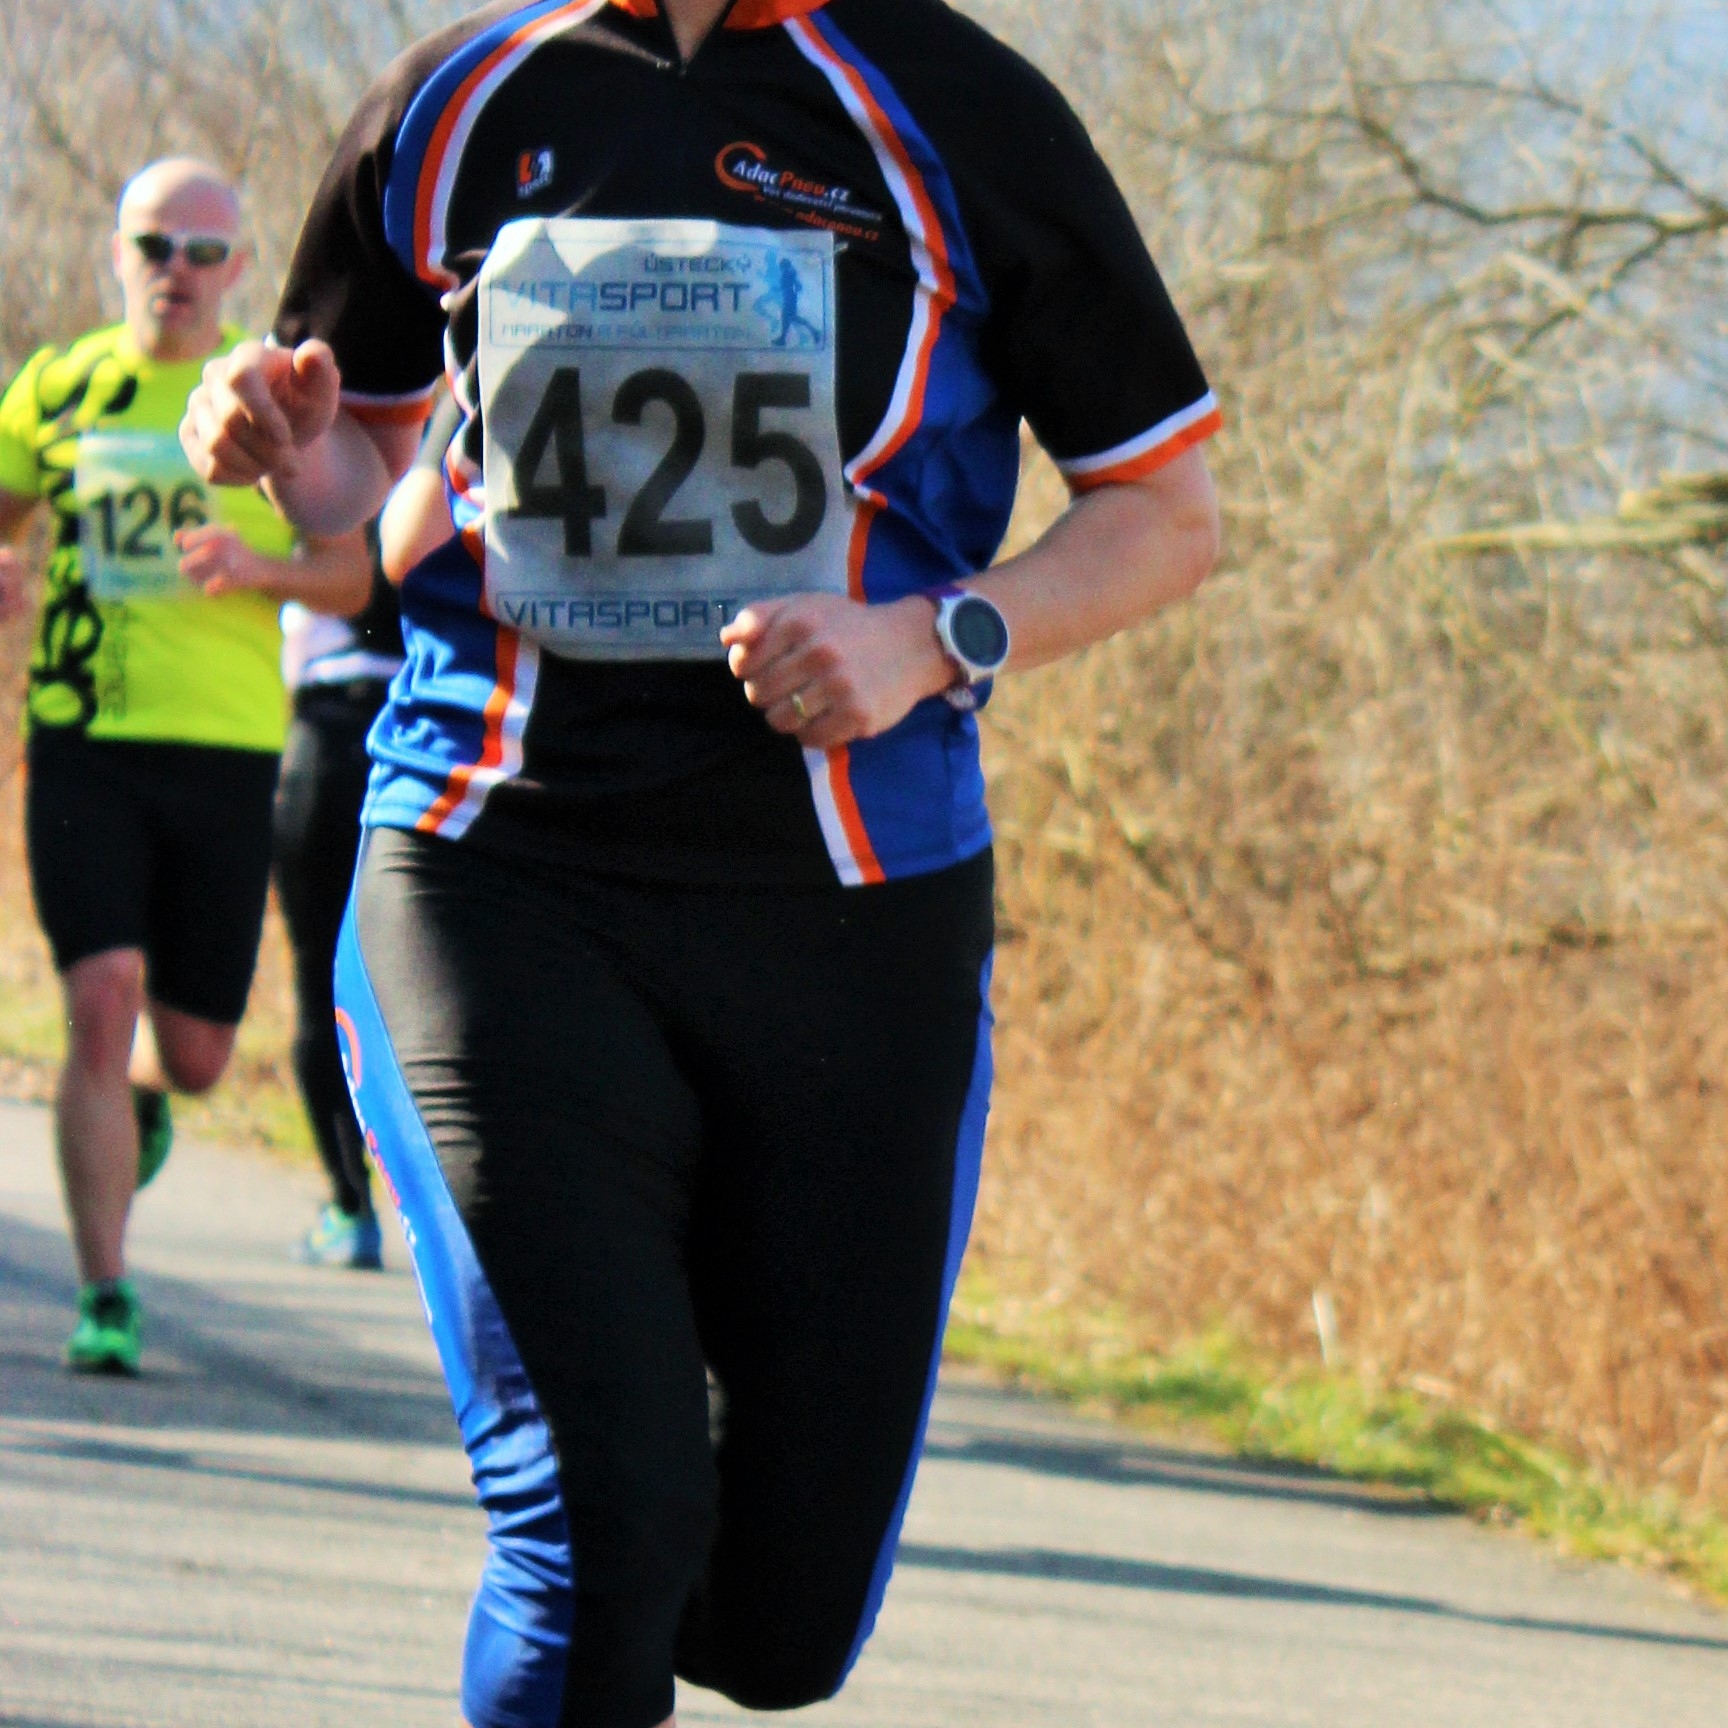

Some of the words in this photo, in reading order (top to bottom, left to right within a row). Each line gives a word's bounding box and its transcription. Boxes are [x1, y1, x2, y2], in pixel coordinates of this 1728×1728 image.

[501, 280, 750, 313] VITASPORT
[507, 367, 826, 558] 425
[90, 480, 208, 559] 126
[503, 599, 738, 628] VITASPORT
